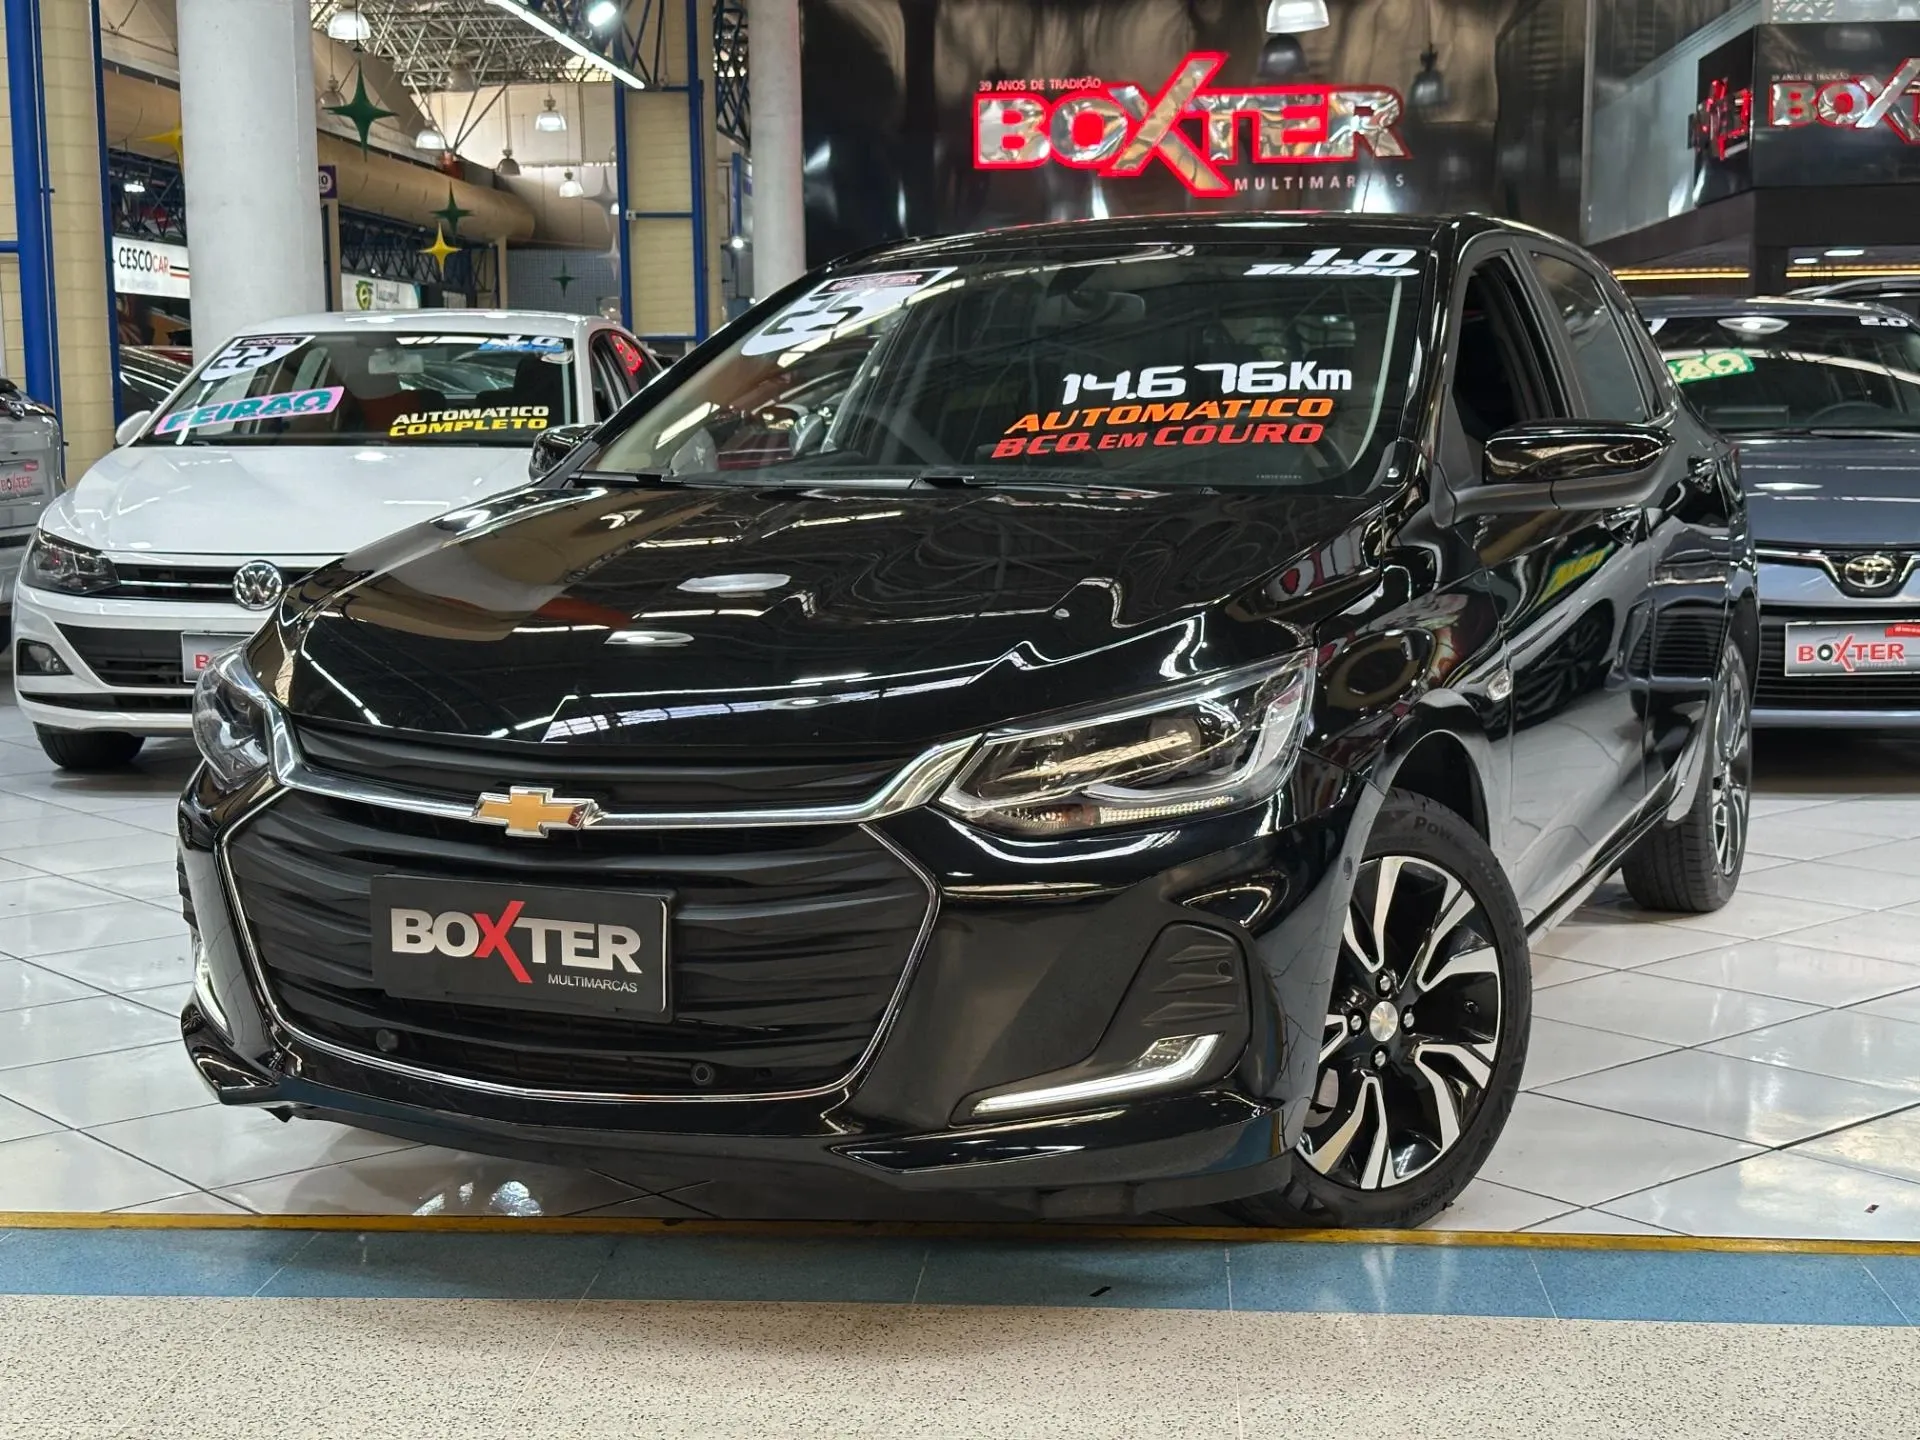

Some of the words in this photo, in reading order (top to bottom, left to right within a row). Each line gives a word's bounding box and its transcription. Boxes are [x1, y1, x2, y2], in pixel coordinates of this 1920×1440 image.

[978, 81, 992, 92] 39
[996, 79, 1027, 91] ANOS
[1030, 79, 1045, 90] DE
[1049, 76, 1101, 91] TRADIÇÃO
[972, 51, 1413, 197] BOXTER
[1234, 174, 1404, 191] MULTIMARAS
[119, 246, 169, 273] CESCOCAR
[1303, 247, 1417, 266] 1.0
[210, 346, 276, 370] 22
[390, 418, 548, 437] COMPLETO
[1097, 432, 1146, 450] EM
[1153, 423, 1324, 446] COURO
[1796, 633, 1905, 672] BOXTER
[390, 900, 643, 984] BOXTER
[547, 973, 638, 994] MULTIMARCAS
